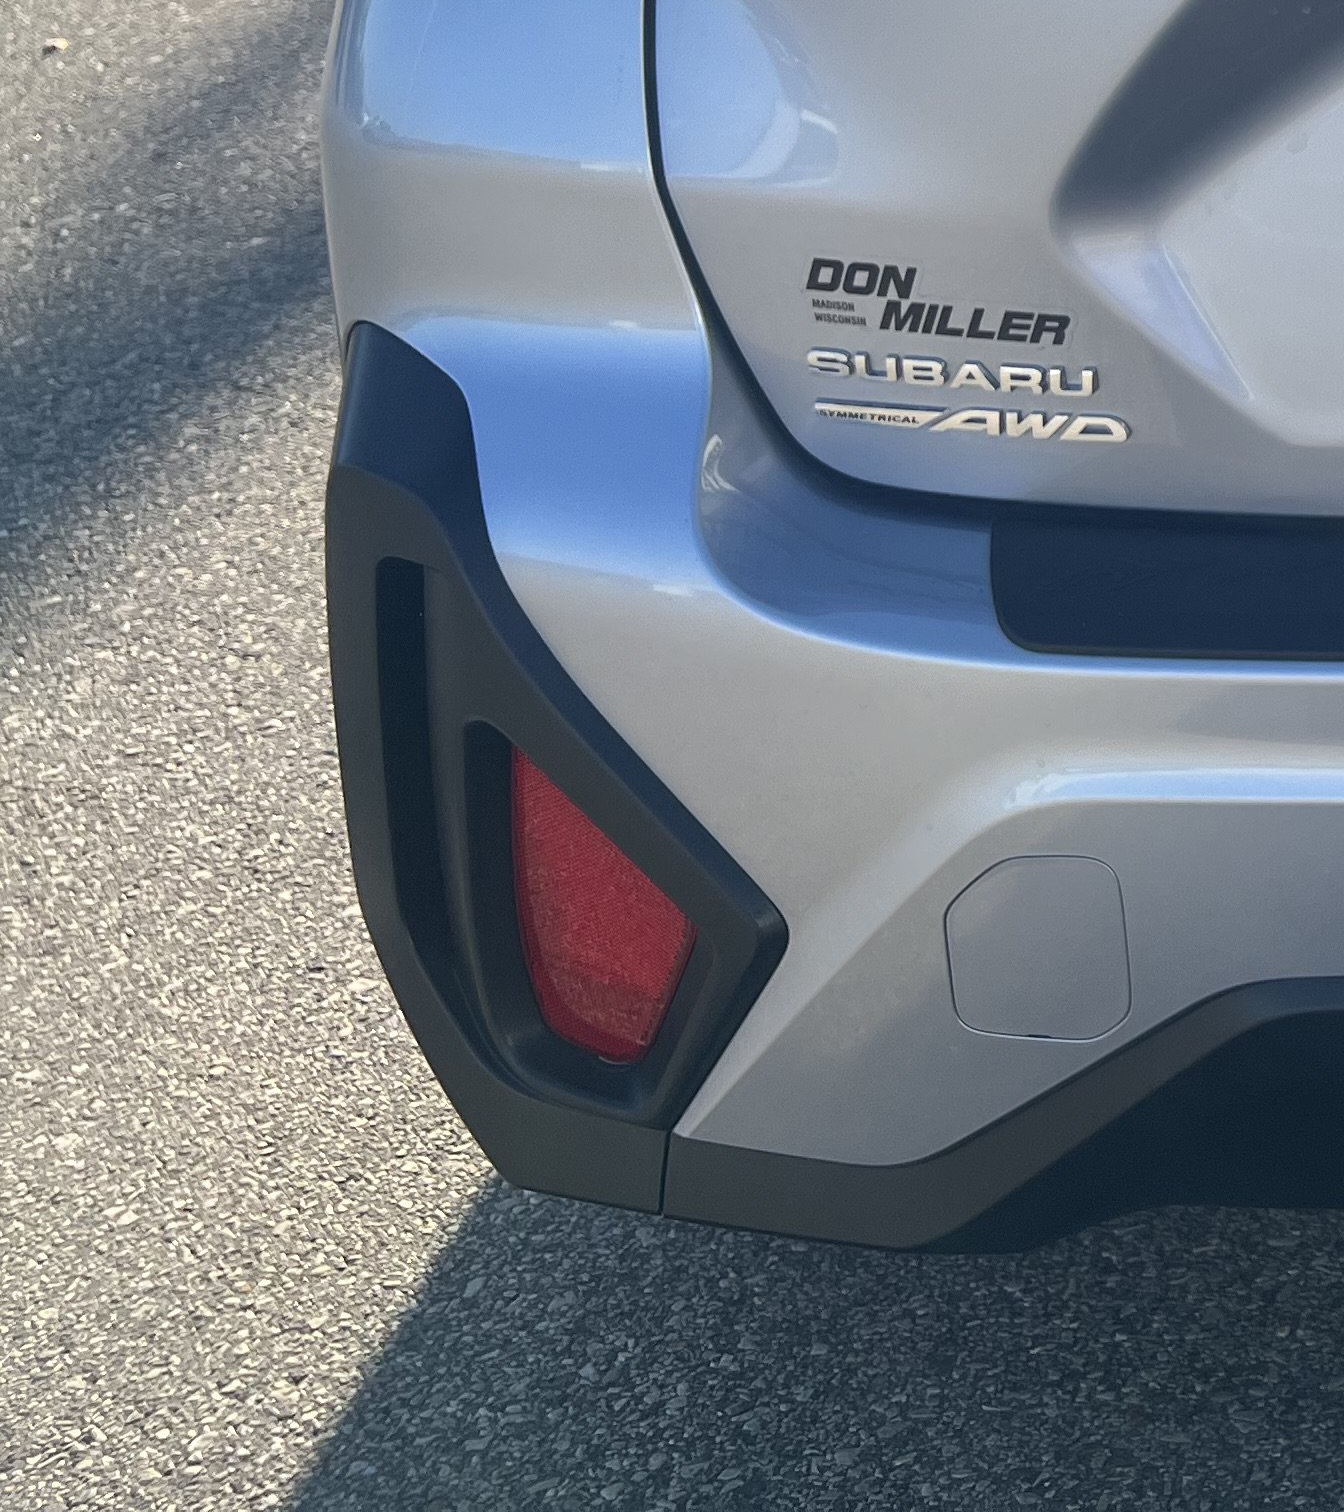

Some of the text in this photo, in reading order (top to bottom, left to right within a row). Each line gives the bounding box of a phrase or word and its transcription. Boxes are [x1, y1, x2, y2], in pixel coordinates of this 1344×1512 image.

[806, 257, 917, 299] DON
[812, 299, 855, 312] MADISON
[814, 312, 867, 326] WISCONSIN
[879, 299, 1071, 345] MILLER
[806, 347, 1100, 397] SUBARU
[818, 407, 1132, 443] SYMMETRICAL AWD
